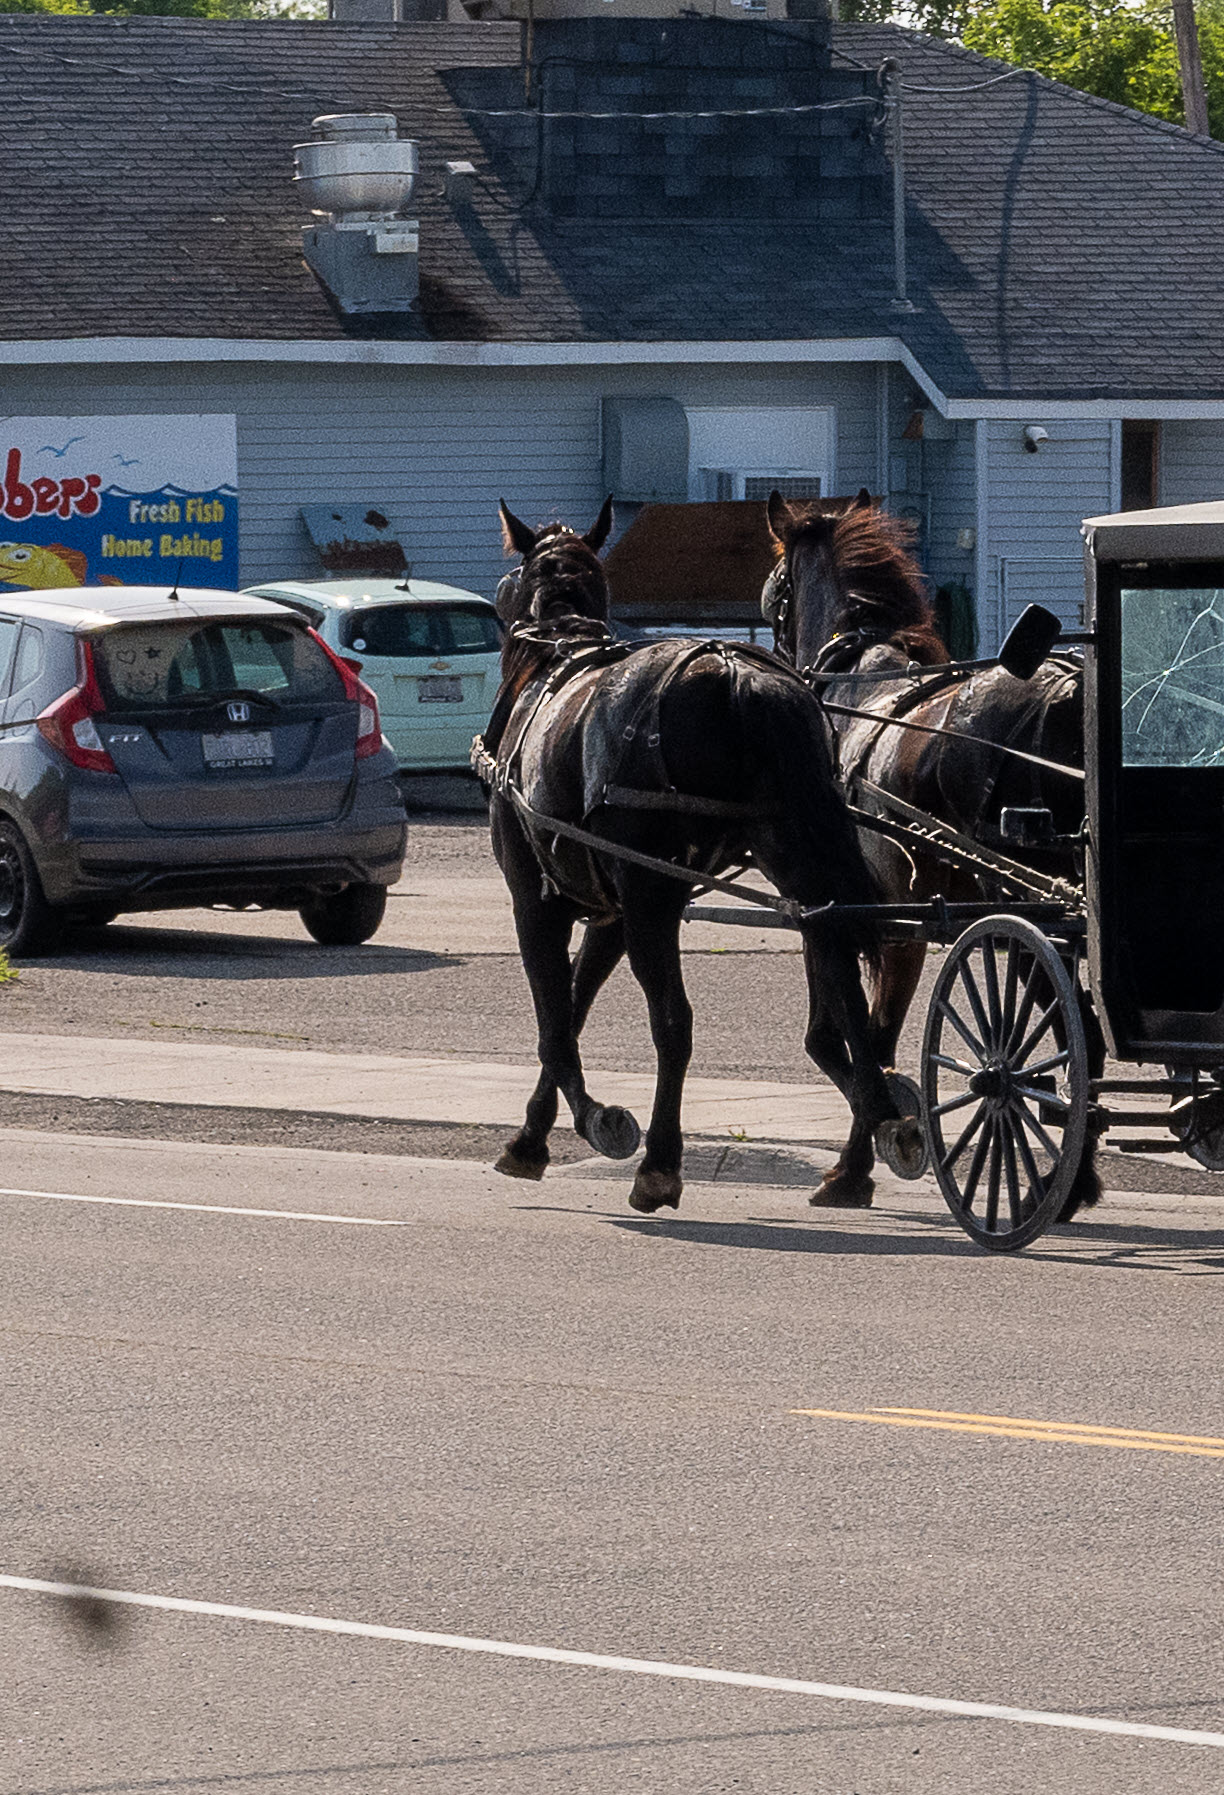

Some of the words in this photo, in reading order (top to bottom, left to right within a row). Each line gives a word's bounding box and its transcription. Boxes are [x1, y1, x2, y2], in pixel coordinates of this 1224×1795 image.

[0, 447, 102, 520] bers
[129, 499, 180, 523] Fresh
[186, 497, 224, 523] Fish
[102, 534, 153, 557] Home
[160, 531, 223, 562] Baking
